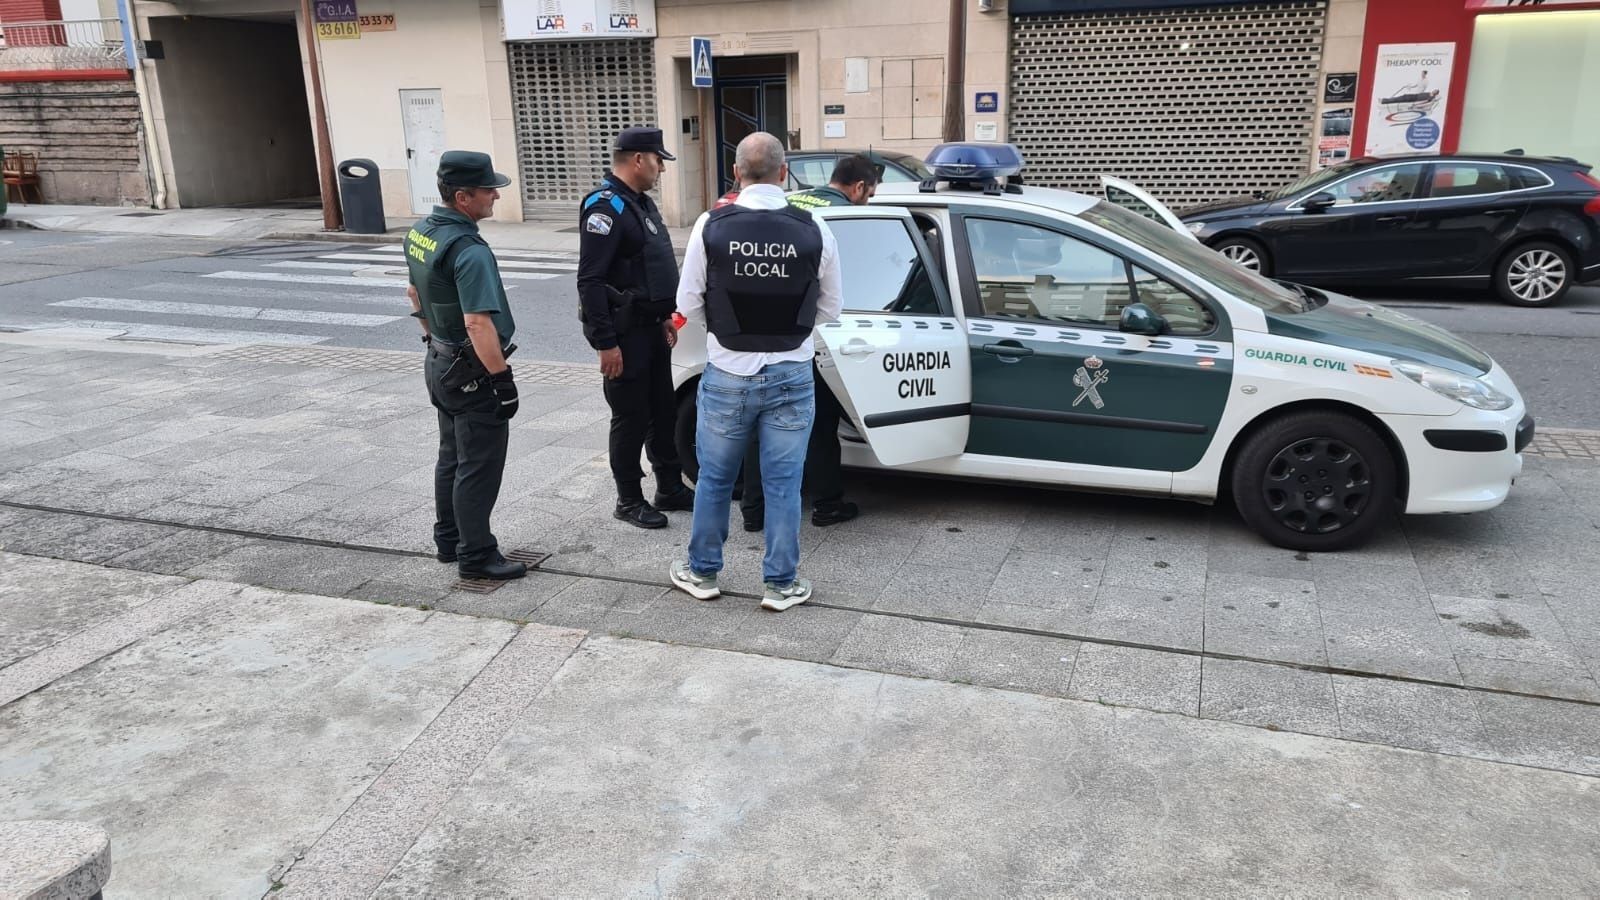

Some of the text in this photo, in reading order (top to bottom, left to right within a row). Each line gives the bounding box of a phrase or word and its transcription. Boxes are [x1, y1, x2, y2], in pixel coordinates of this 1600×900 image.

[536, 18, 564, 30] LAR
[610, 16, 638, 28] LAR
[1386, 58, 1443, 68] THERAPY COOL
[408, 228, 438, 253] GUARDIA
[729, 241, 798, 258] POLICIA
[409, 244, 425, 263] CIVIL
[734, 261, 790, 278] LOCAL
[882, 350, 951, 373] GUARDIA
[1244, 348, 1348, 372] GUARDIA CIVIL
[898, 377, 936, 399] CIVIL
